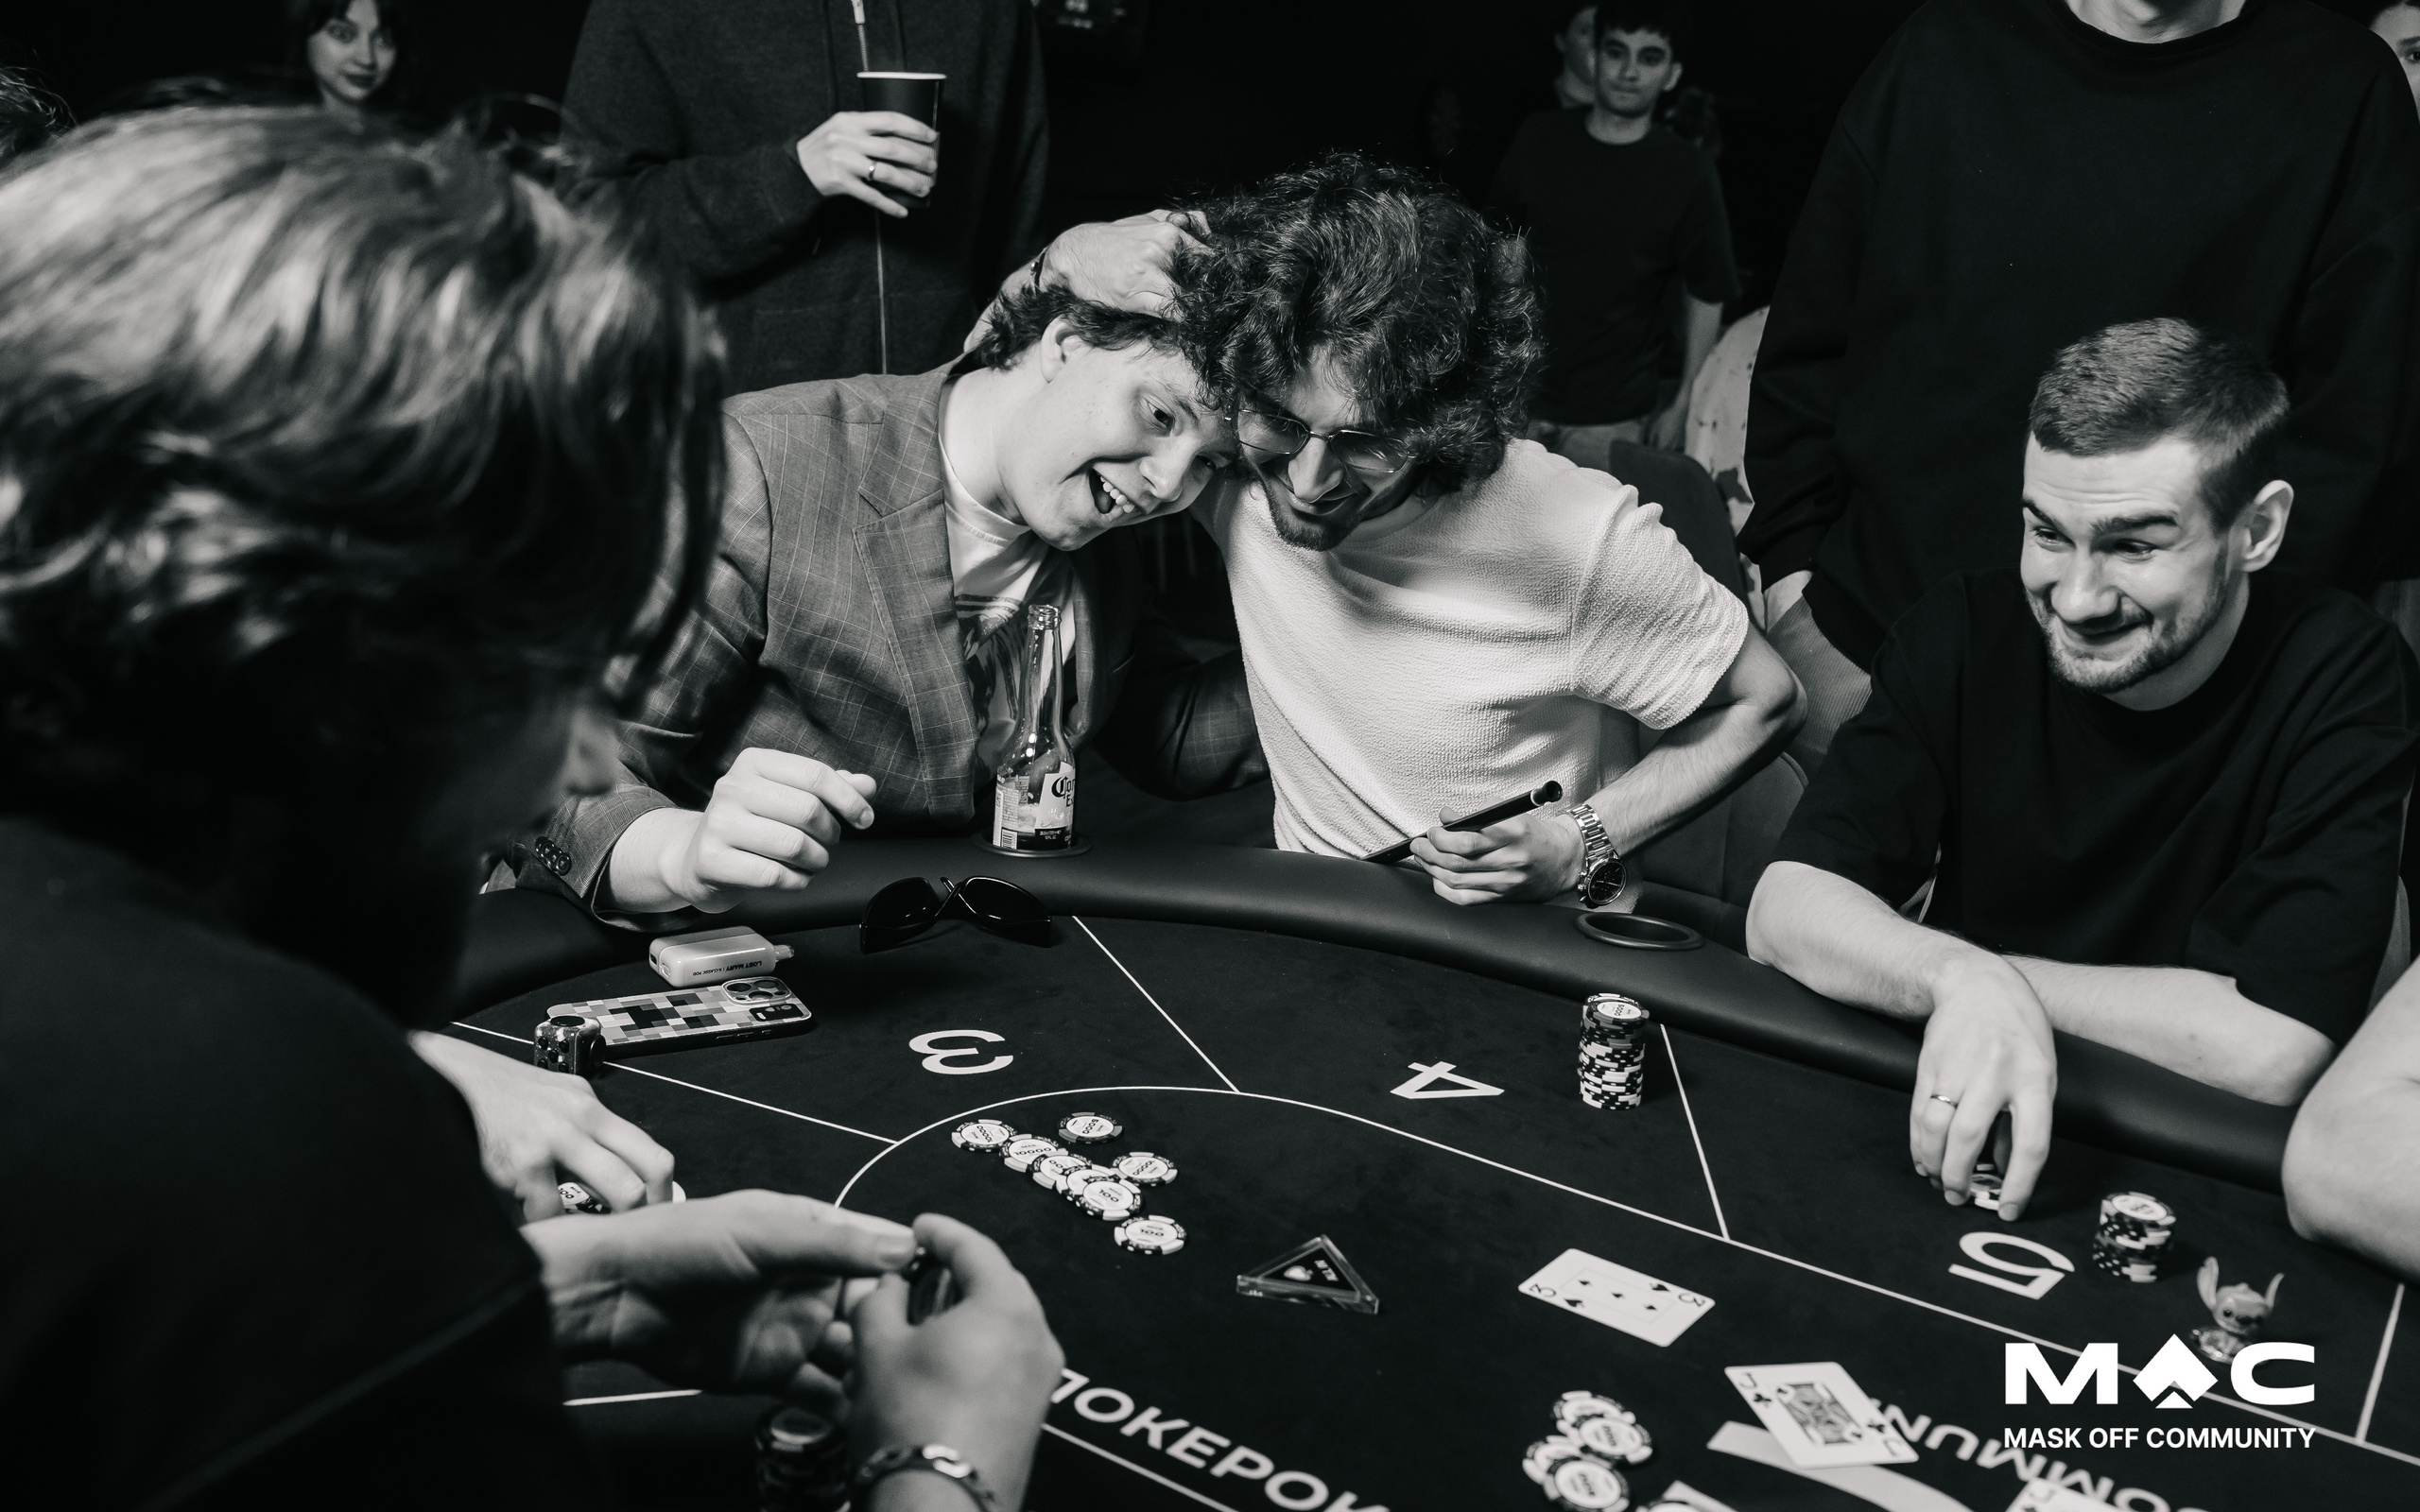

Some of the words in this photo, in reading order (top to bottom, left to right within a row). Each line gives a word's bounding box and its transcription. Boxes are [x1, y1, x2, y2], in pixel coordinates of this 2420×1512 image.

[726, 963, 744, 971] MARY
[745, 960, 763, 969] LOST
[908, 1029, 1014, 1074] 3
[1390, 1060, 1505, 1099] 4
[1082, 1118, 1098, 1134] 5000
[1013, 1146, 1052, 1156] 10000
[1099, 1189, 1119, 1202] 100
[1948, 1231, 2075, 1299] 5
[1530, 1283, 1556, 1298] 3
[1678, 1293, 1705, 1307] 3
